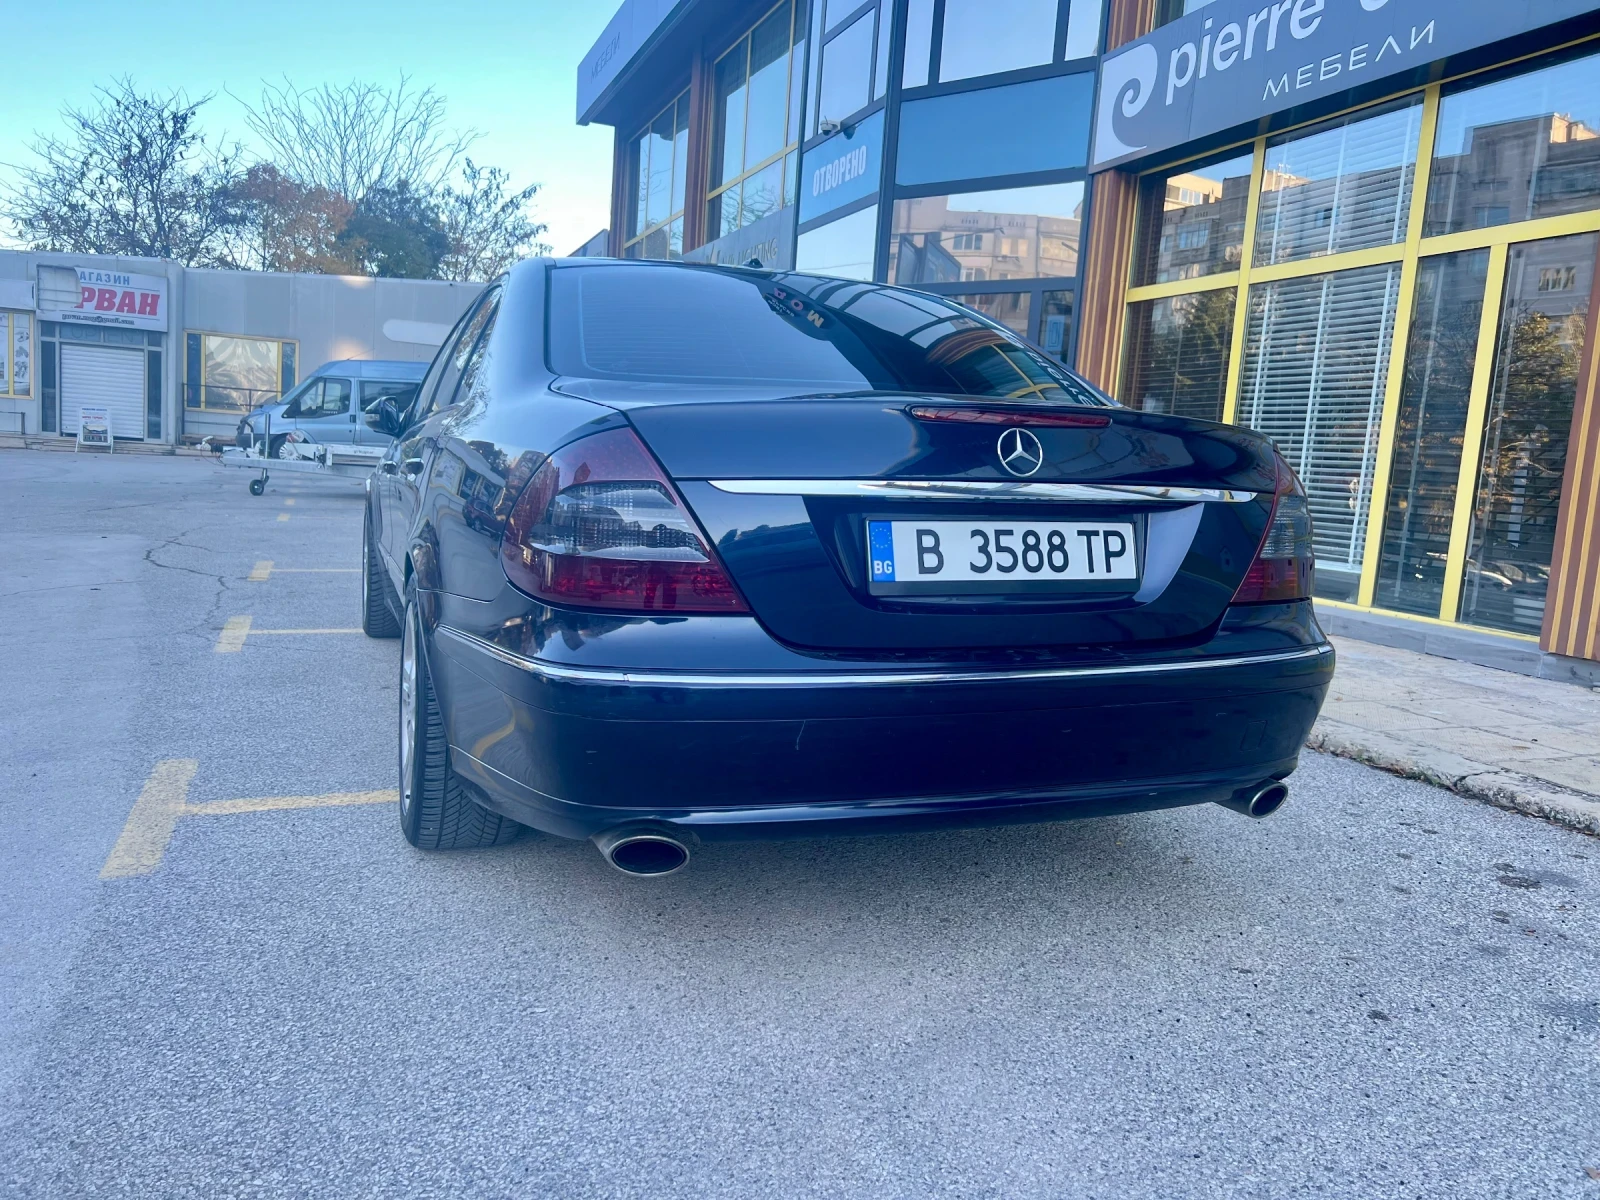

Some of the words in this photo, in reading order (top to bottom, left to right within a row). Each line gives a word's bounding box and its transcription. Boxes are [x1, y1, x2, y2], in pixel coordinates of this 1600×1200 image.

[591, 31, 621, 84] МЕБЕЛИ
[1166, 0, 1324, 106] pierre
[1262, 19, 1435, 101] МЕБЕЛИ
[812, 145, 867, 197] ОТВОРЕНО
[74, 286, 161, 316] РВАН
[873, 560, 893, 574] BG
[915, 528, 945, 574] B
[969, 529, 1069, 573] 3588
[1076, 530, 1127, 573] TP
